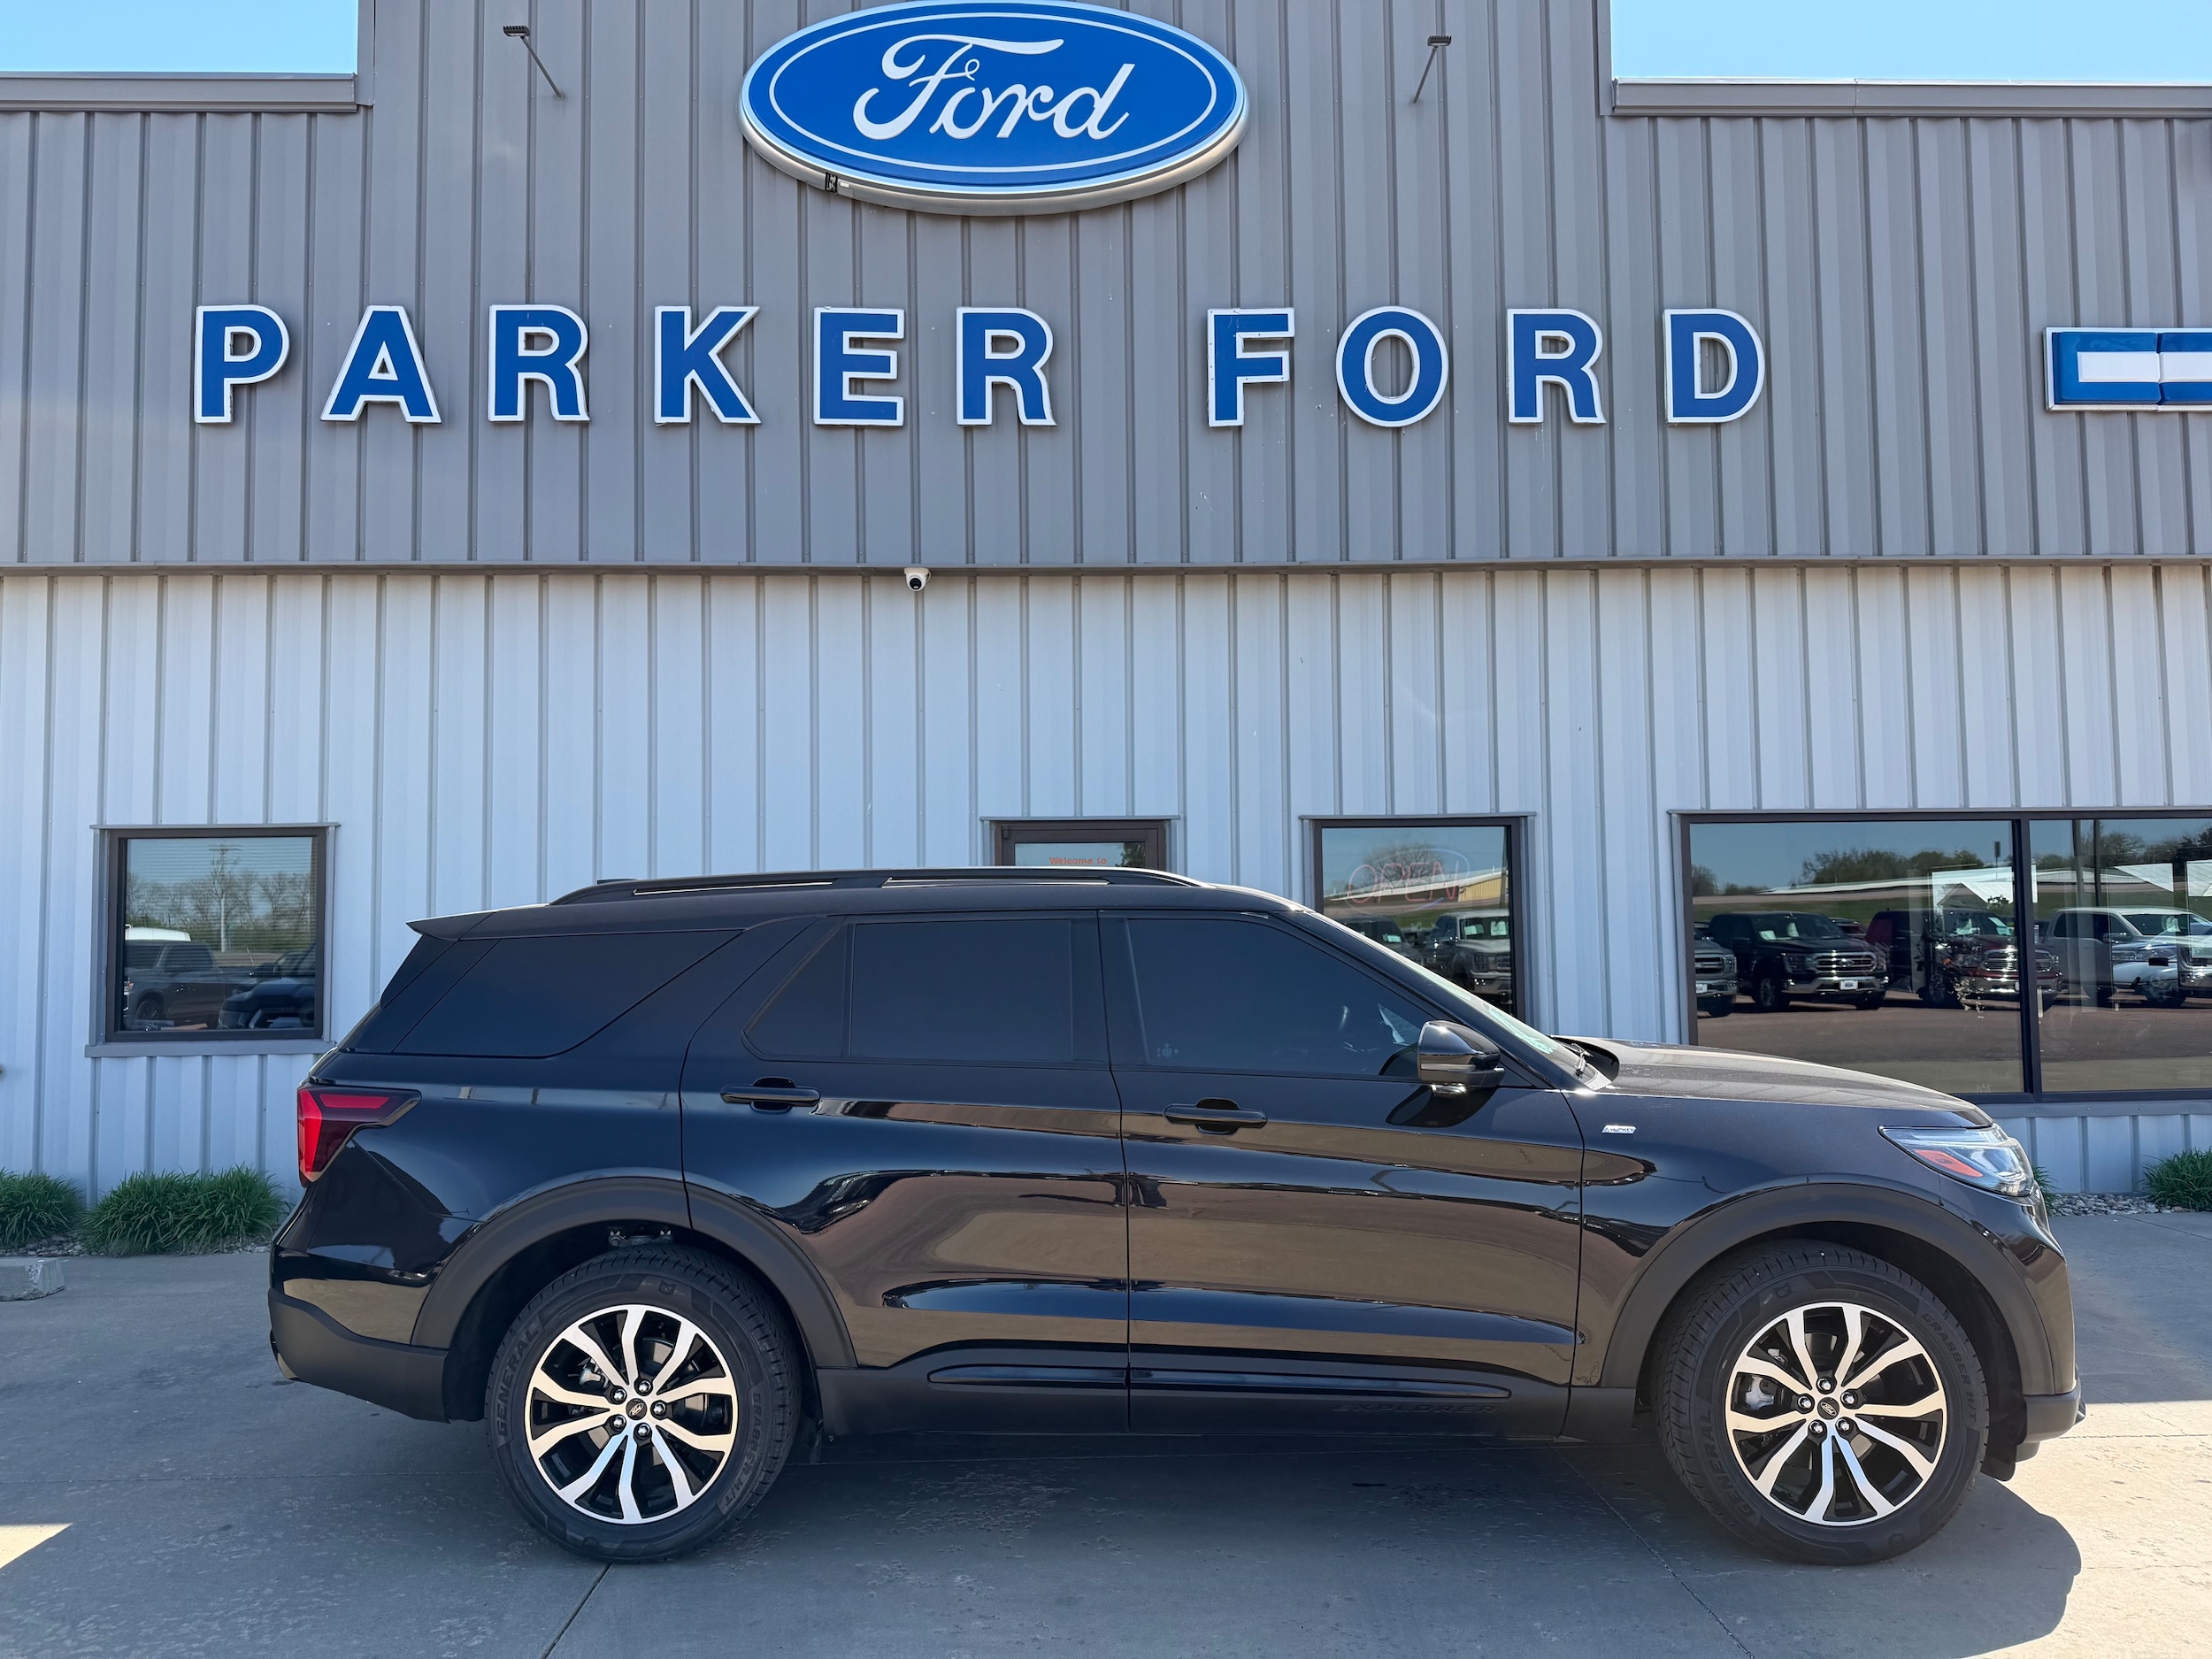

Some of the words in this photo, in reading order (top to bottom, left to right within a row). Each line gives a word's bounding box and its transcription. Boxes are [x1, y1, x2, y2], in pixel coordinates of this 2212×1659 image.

[853, 34, 1135, 140] Ford
[194, 303, 1057, 426] PARKER
[1207, 305, 1766, 427] FORD
[1347, 860, 1460, 904] OPEN
[496, 1329, 539, 1437] GENERAL
[1333, 1403, 1496, 1414] EXPLORER
[1921, 1313, 1971, 1385] GRABBER
[1966, 1391, 1977, 1422] H/T
[1700, 1409, 1756, 1517] GENERAL
